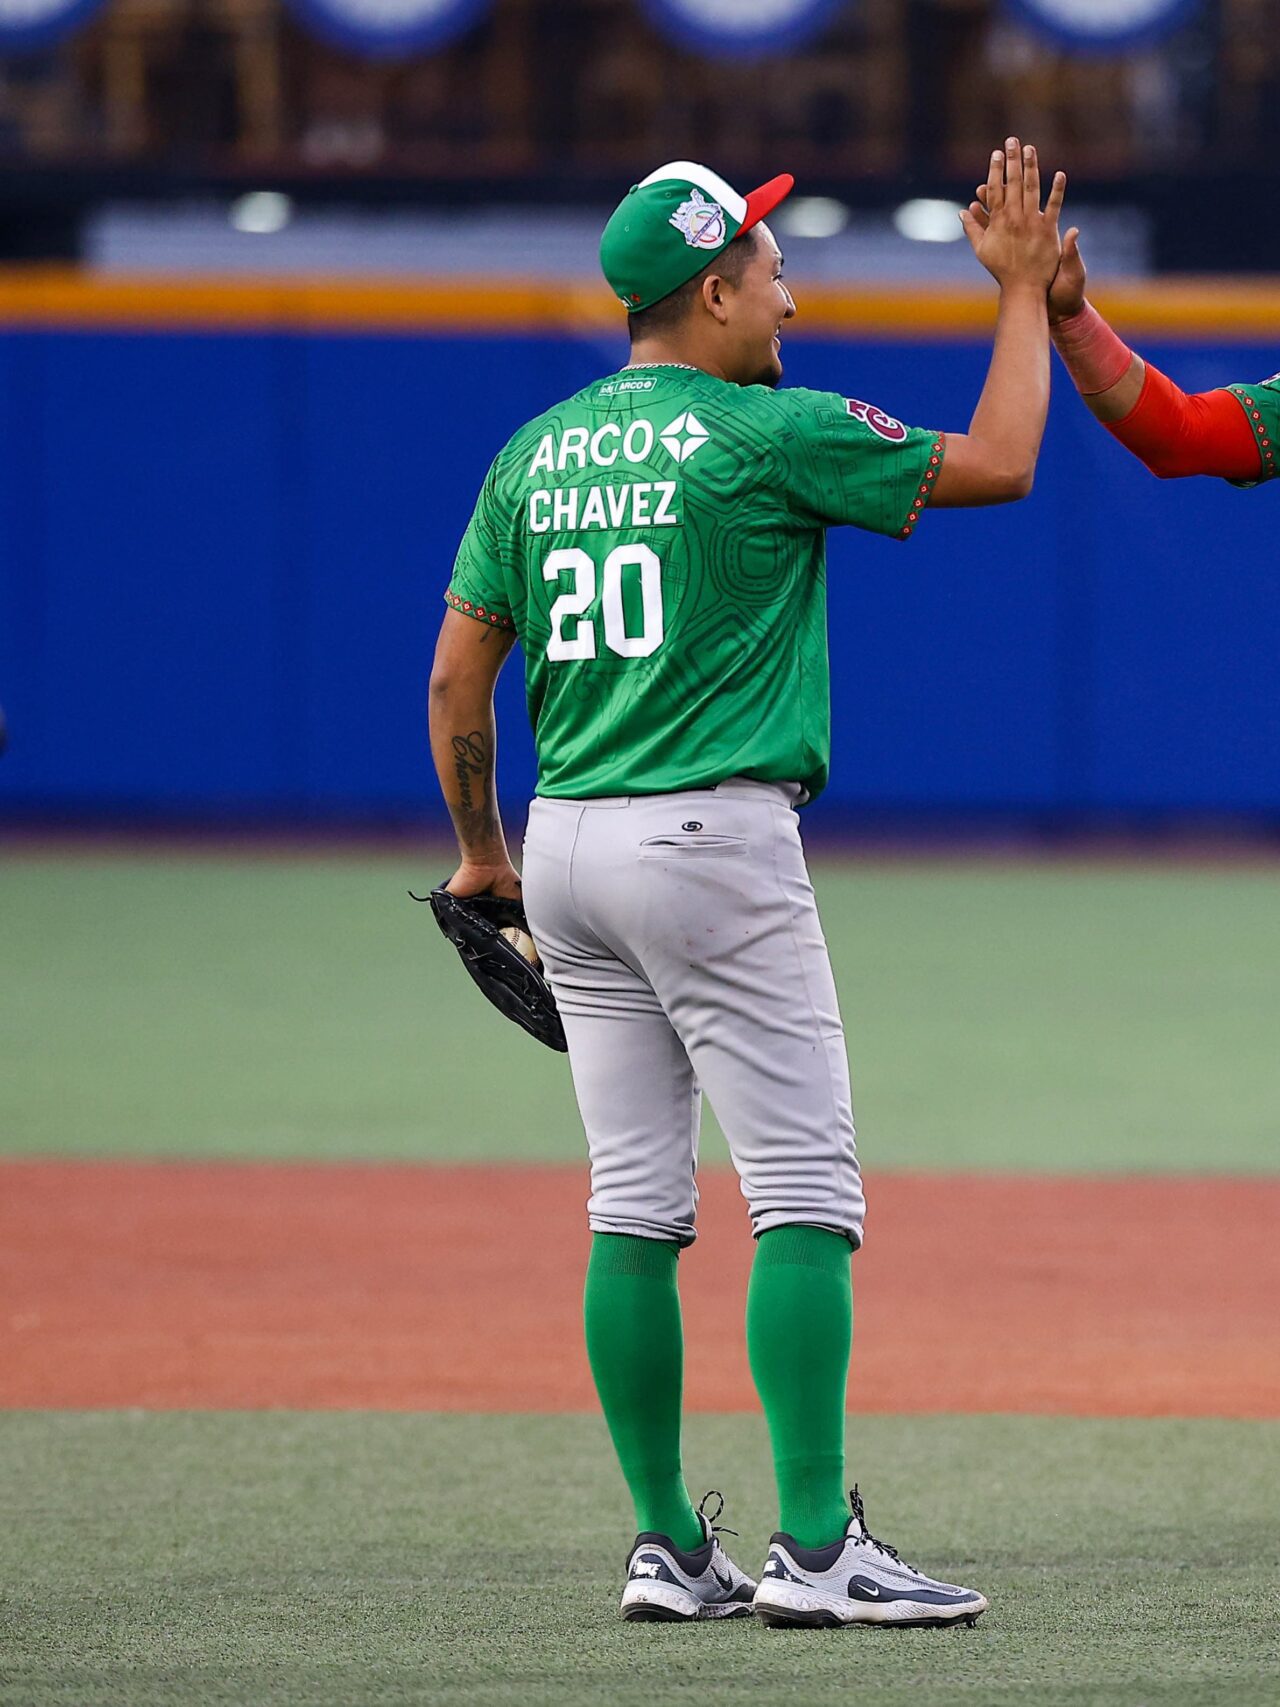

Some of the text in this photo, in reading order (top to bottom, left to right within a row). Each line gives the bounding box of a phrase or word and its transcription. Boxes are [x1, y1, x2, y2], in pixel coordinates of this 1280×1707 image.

[528, 419, 654, 477] ARCO
[529, 481, 677, 533] CHAVEZ
[542, 543, 664, 662] 20
